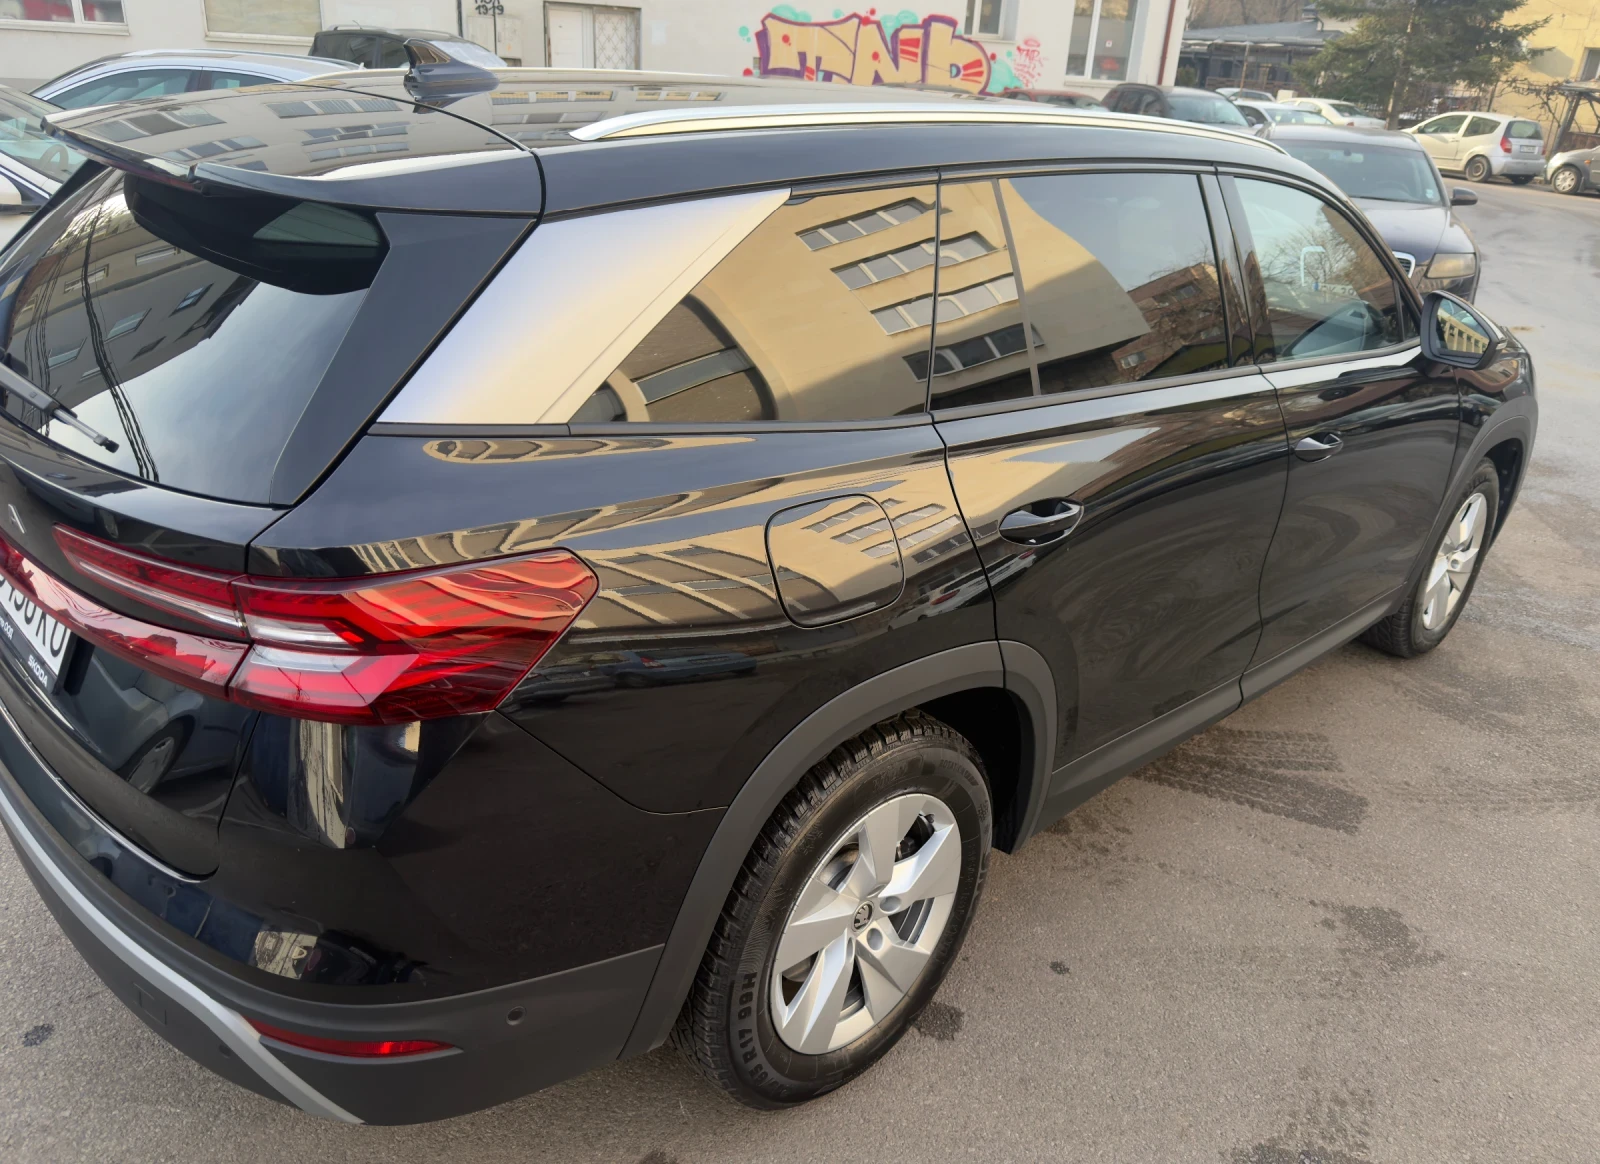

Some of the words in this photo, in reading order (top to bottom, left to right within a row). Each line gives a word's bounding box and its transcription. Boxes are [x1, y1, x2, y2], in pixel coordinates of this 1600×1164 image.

[27, 654, 48, 687] SKODA
[738, 971, 758, 1020] 99H
[739, 1028, 758, 1064] R17
